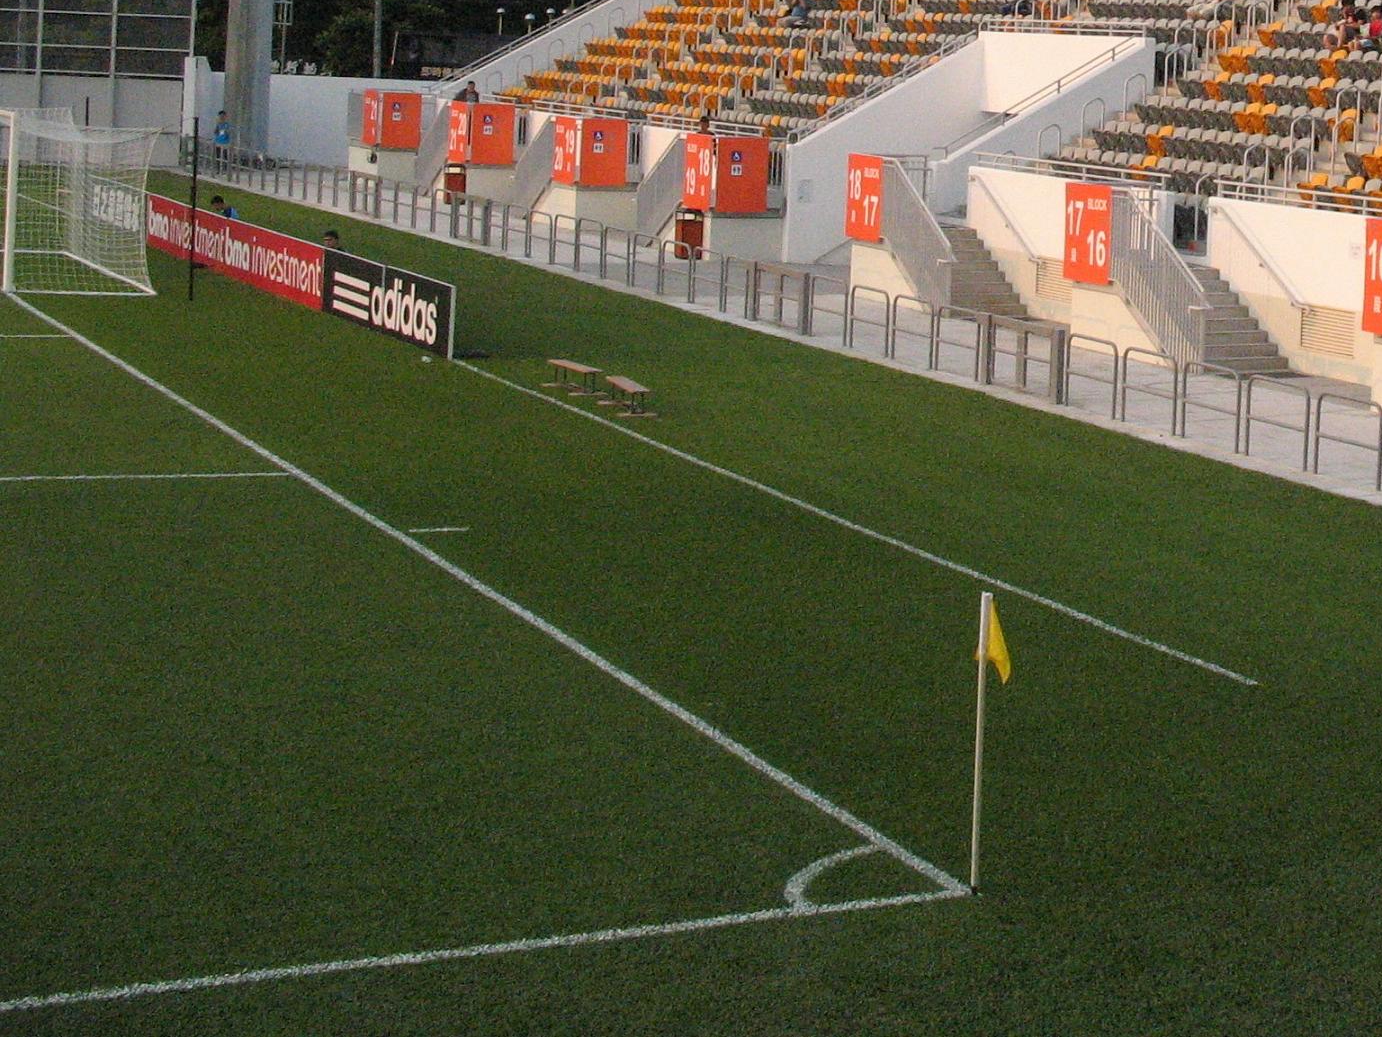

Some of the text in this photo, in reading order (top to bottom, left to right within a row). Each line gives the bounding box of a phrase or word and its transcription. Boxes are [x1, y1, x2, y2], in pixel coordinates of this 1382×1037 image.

[565, 128, 575, 154] 19
[698, 148, 710, 177] 18
[685, 166, 696, 195] 19
[849, 168, 862, 200] 18
[863, 194, 879, 226] 17
[1067, 198, 1107, 236] 17 BLOCK
[149, 200, 169, 240] bma
[225, 227, 250, 271] bma
[251, 236, 322, 297] investment
[1087, 229, 1106, 267] 16
[371, 278, 438, 345] adidas
